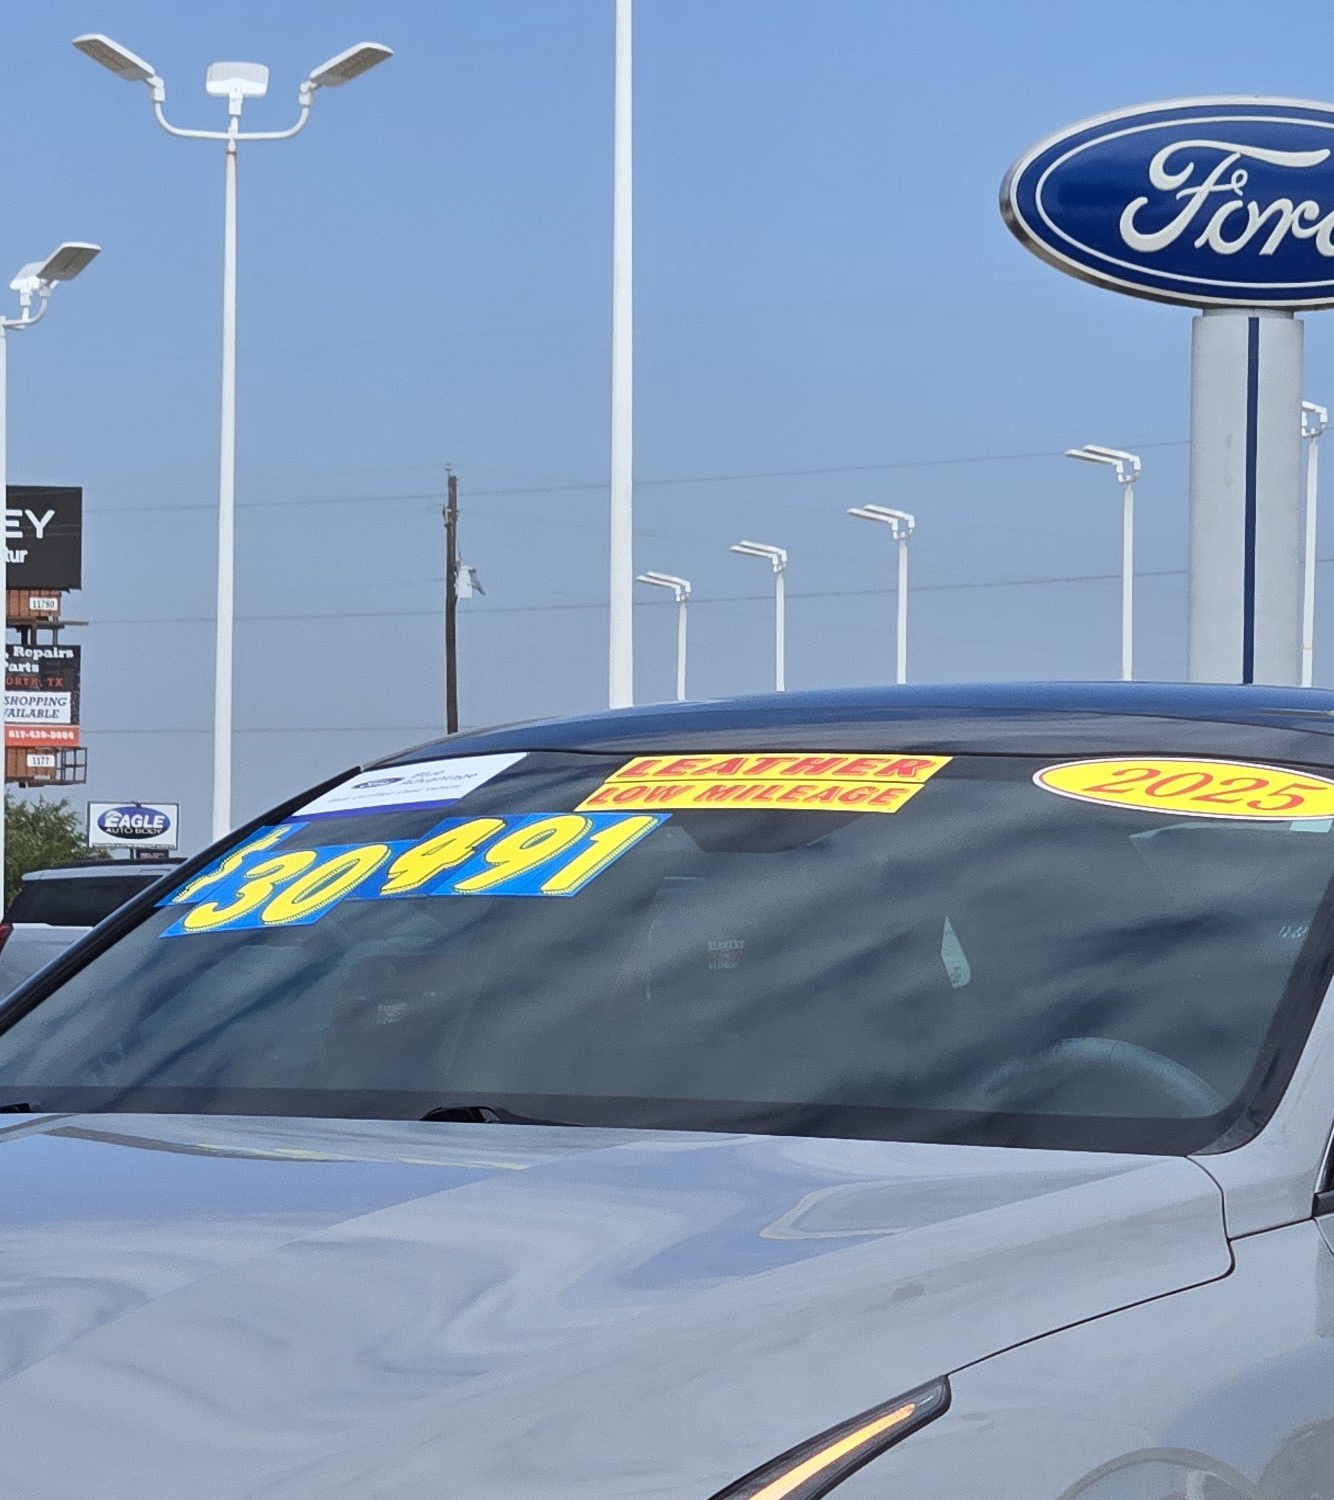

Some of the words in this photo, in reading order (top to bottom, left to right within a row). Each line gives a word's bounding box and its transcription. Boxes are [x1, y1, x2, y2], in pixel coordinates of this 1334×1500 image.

[13, 646, 74, 660] Repairs
[47, 677, 64, 687] TX
[4, 696, 67, 708] SHOPPING
[617, 756, 928, 778] LEATHER
[586, 783, 695, 804] LOW
[695, 783, 907, 806] MILEAGE
[1081, 768, 1327, 811] 2025
[104, 810, 166, 829] EAGLE
